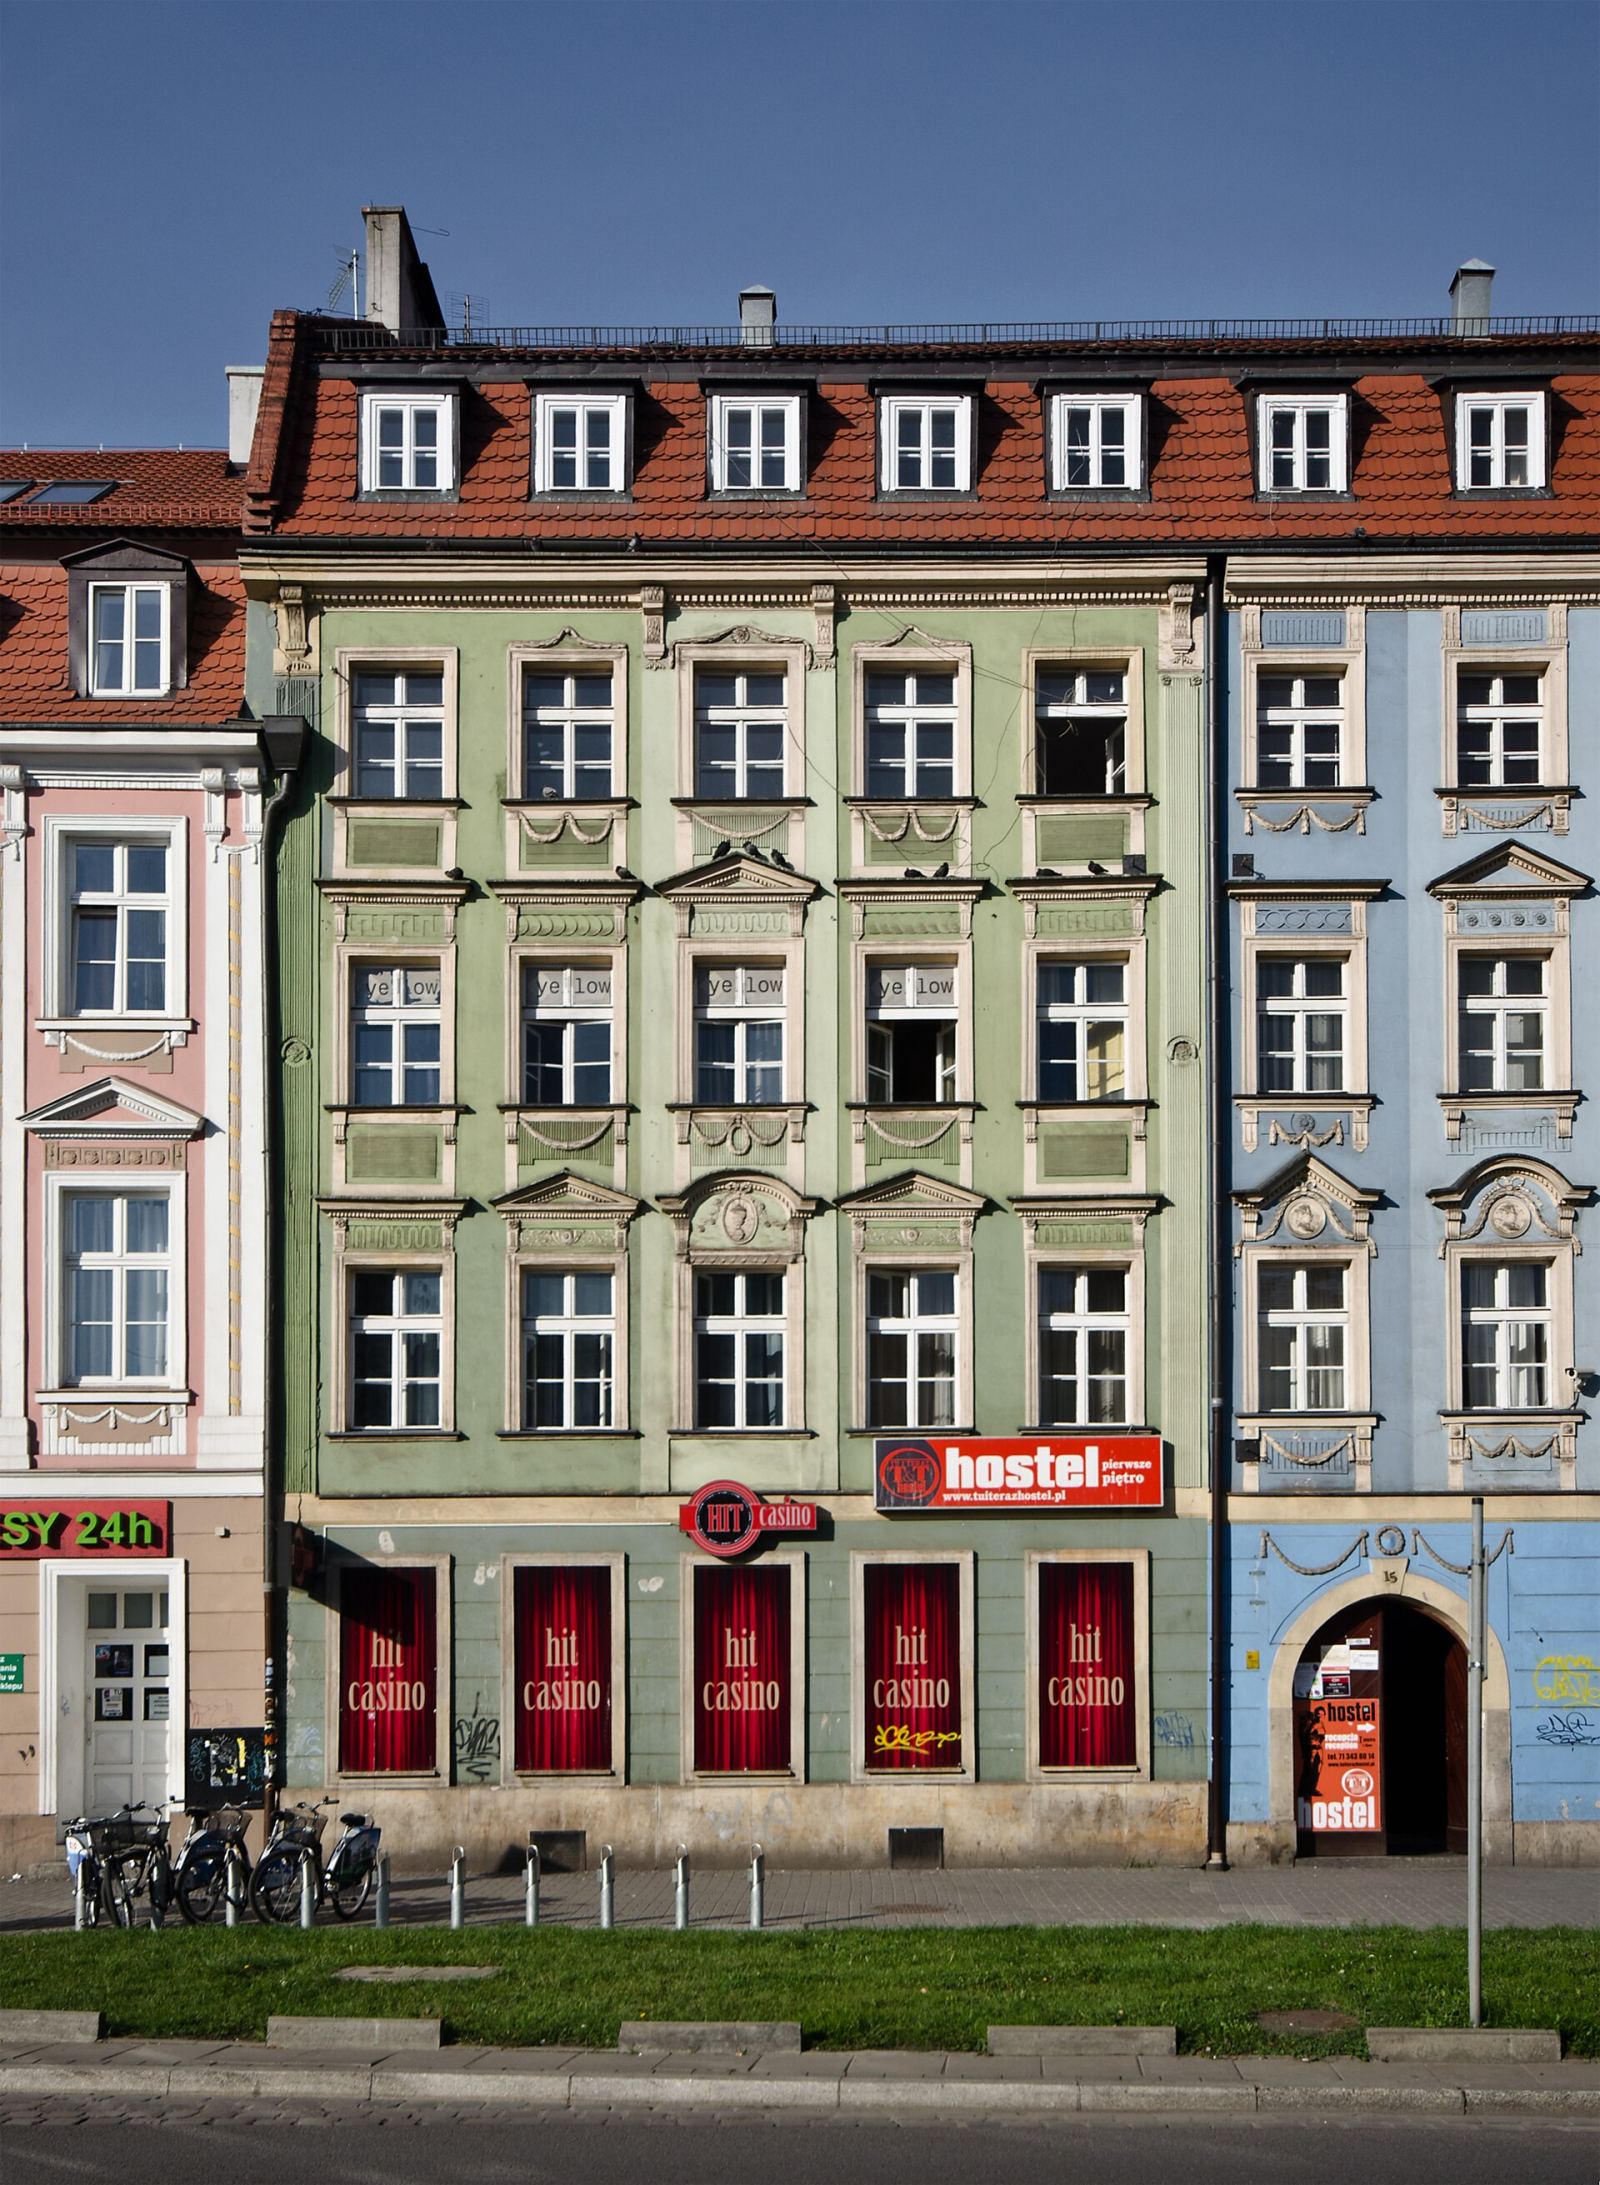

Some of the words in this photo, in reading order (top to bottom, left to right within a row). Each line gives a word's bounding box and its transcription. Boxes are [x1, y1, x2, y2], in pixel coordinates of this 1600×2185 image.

[945, 1446, 1099, 1489] hostel
[1101, 1459, 1152, 1471] pierwsze
[1102, 1471, 1145, 1487] piętro
[707, 1503, 744, 1533] HIT
[759, 1496, 811, 1527] casino
[943, 1490, 1066, 1503] www.tuiterazhostel.pl
[75, 1511, 152, 1545] 24h
[1384, 1570, 1398, 1584] 15
[371, 1628, 404, 1668] hit
[545, 1627, 579, 1667] hit
[725, 1627, 758, 1668] hit
[895, 1625, 928, 1665] hit
[1070, 1623, 1103, 1663] hit
[348, 1672, 426, 1711] casino
[523, 1671, 601, 1711] casino
[703, 1672, 780, 1711] casino
[873, 1670, 950, 1708] casino
[1048, 1667, 1125, 1706] casino
[1327, 1702, 1375, 1722] hostel
[1297, 1796, 1375, 1829] hostel
